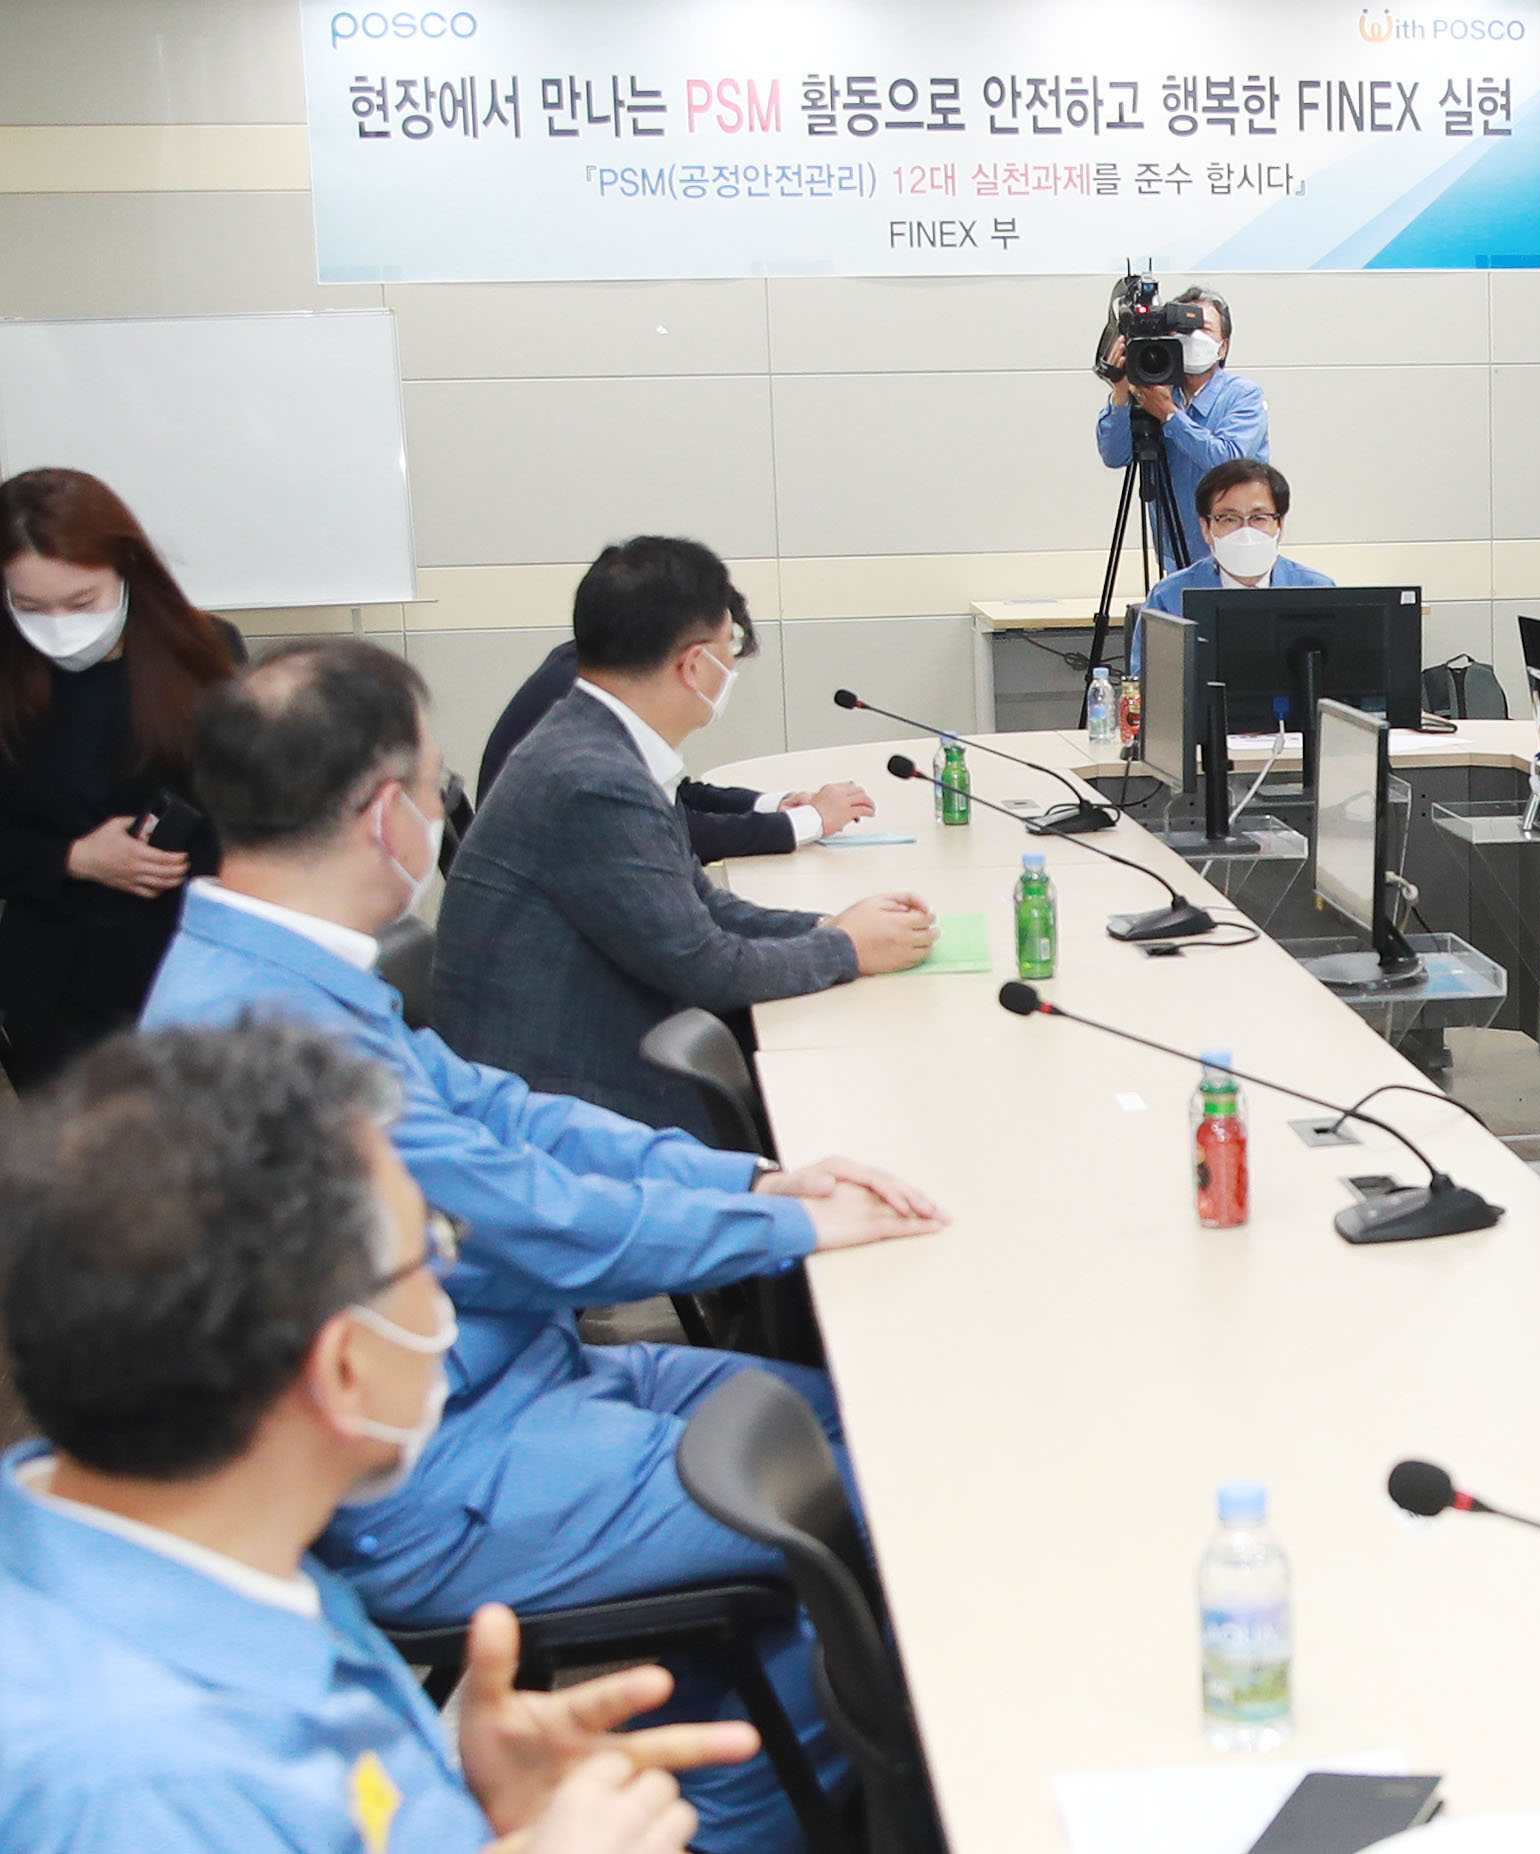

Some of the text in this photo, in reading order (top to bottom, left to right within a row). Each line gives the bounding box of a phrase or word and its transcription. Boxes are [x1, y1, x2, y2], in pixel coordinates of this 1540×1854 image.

[331, 10, 478, 49] posco
[1433, 18, 1526, 41] POSCO
[349, 74, 1513, 140] 현장에서 만나는 PSM 활동으로 안전하고 행복한 FINEX 실현
[891, 163, 956, 197] 12대
[971, 163, 1122, 196] 실천과제를
[1135, 163, 1192, 195] 준수
[890, 218, 1020, 250] FINEX 부
